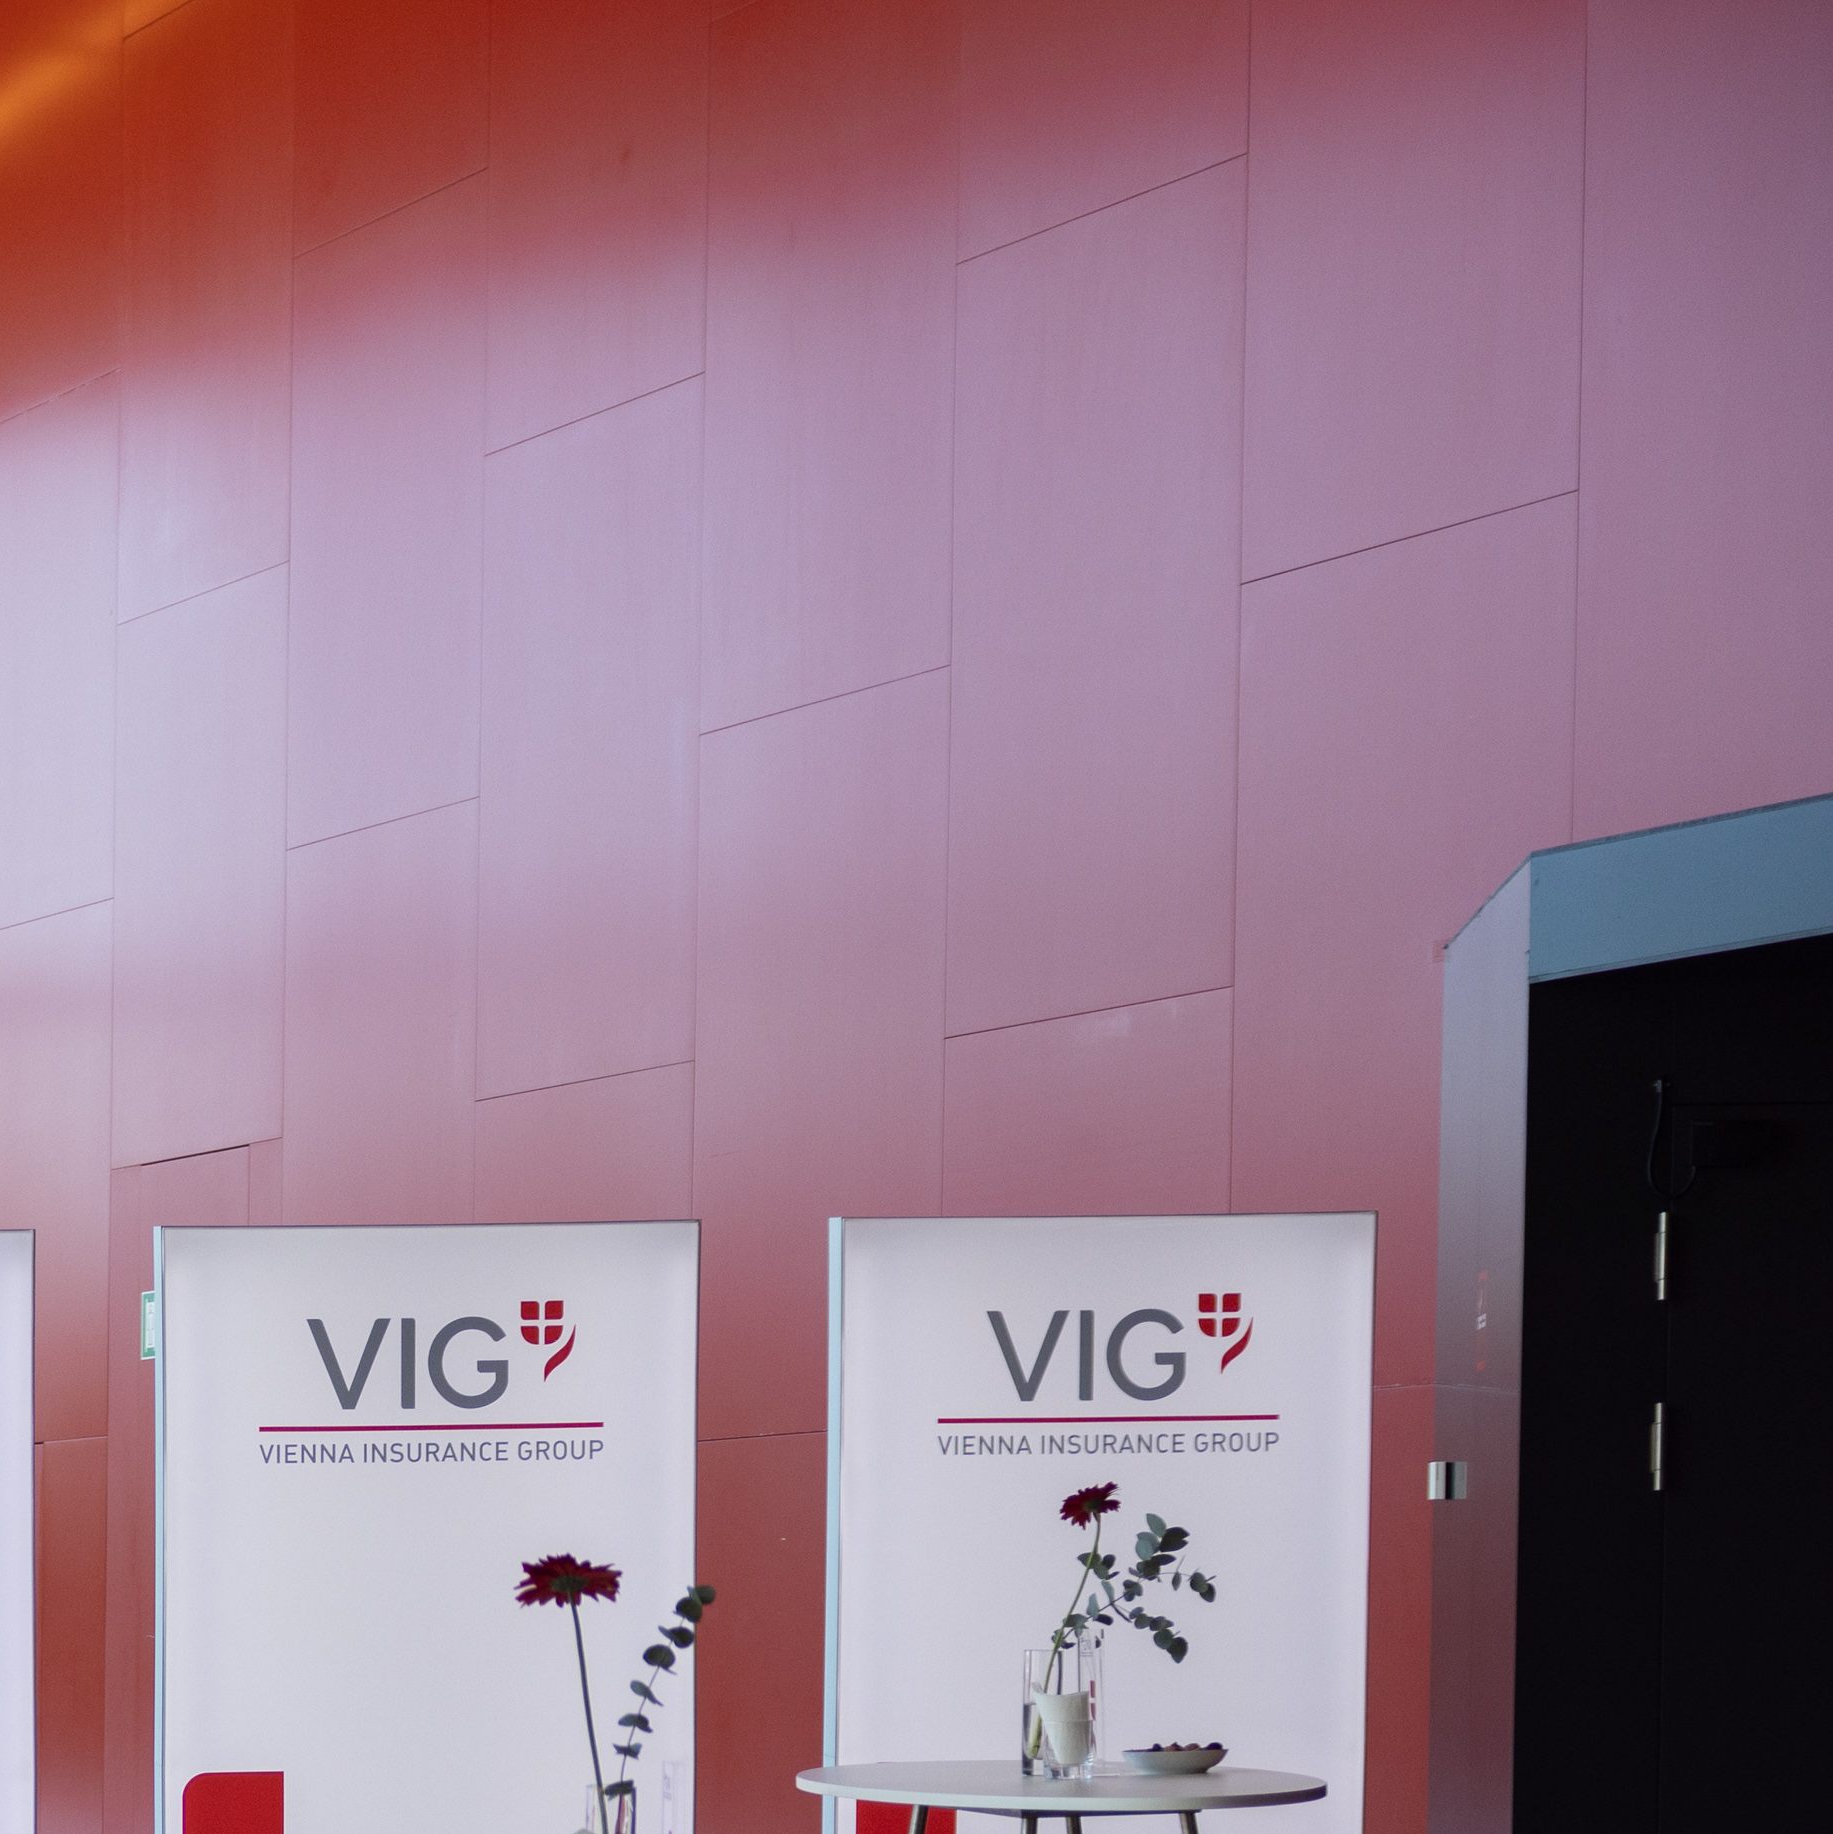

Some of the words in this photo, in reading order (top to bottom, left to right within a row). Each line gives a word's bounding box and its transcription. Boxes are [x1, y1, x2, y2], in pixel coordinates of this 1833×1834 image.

[307, 1317, 508, 1409] VIG
[987, 1309, 1186, 1401] VIG
[259, 1443, 355, 1464] VIENNA
[363, 1441, 509, 1463] INSURANCE
[517, 1439, 604, 1461] GROUP
[937, 1435, 1033, 1455] VIENNA
[1041, 1433, 1186, 1455] INSURANCE
[1194, 1432, 1279, 1453] GROUP
